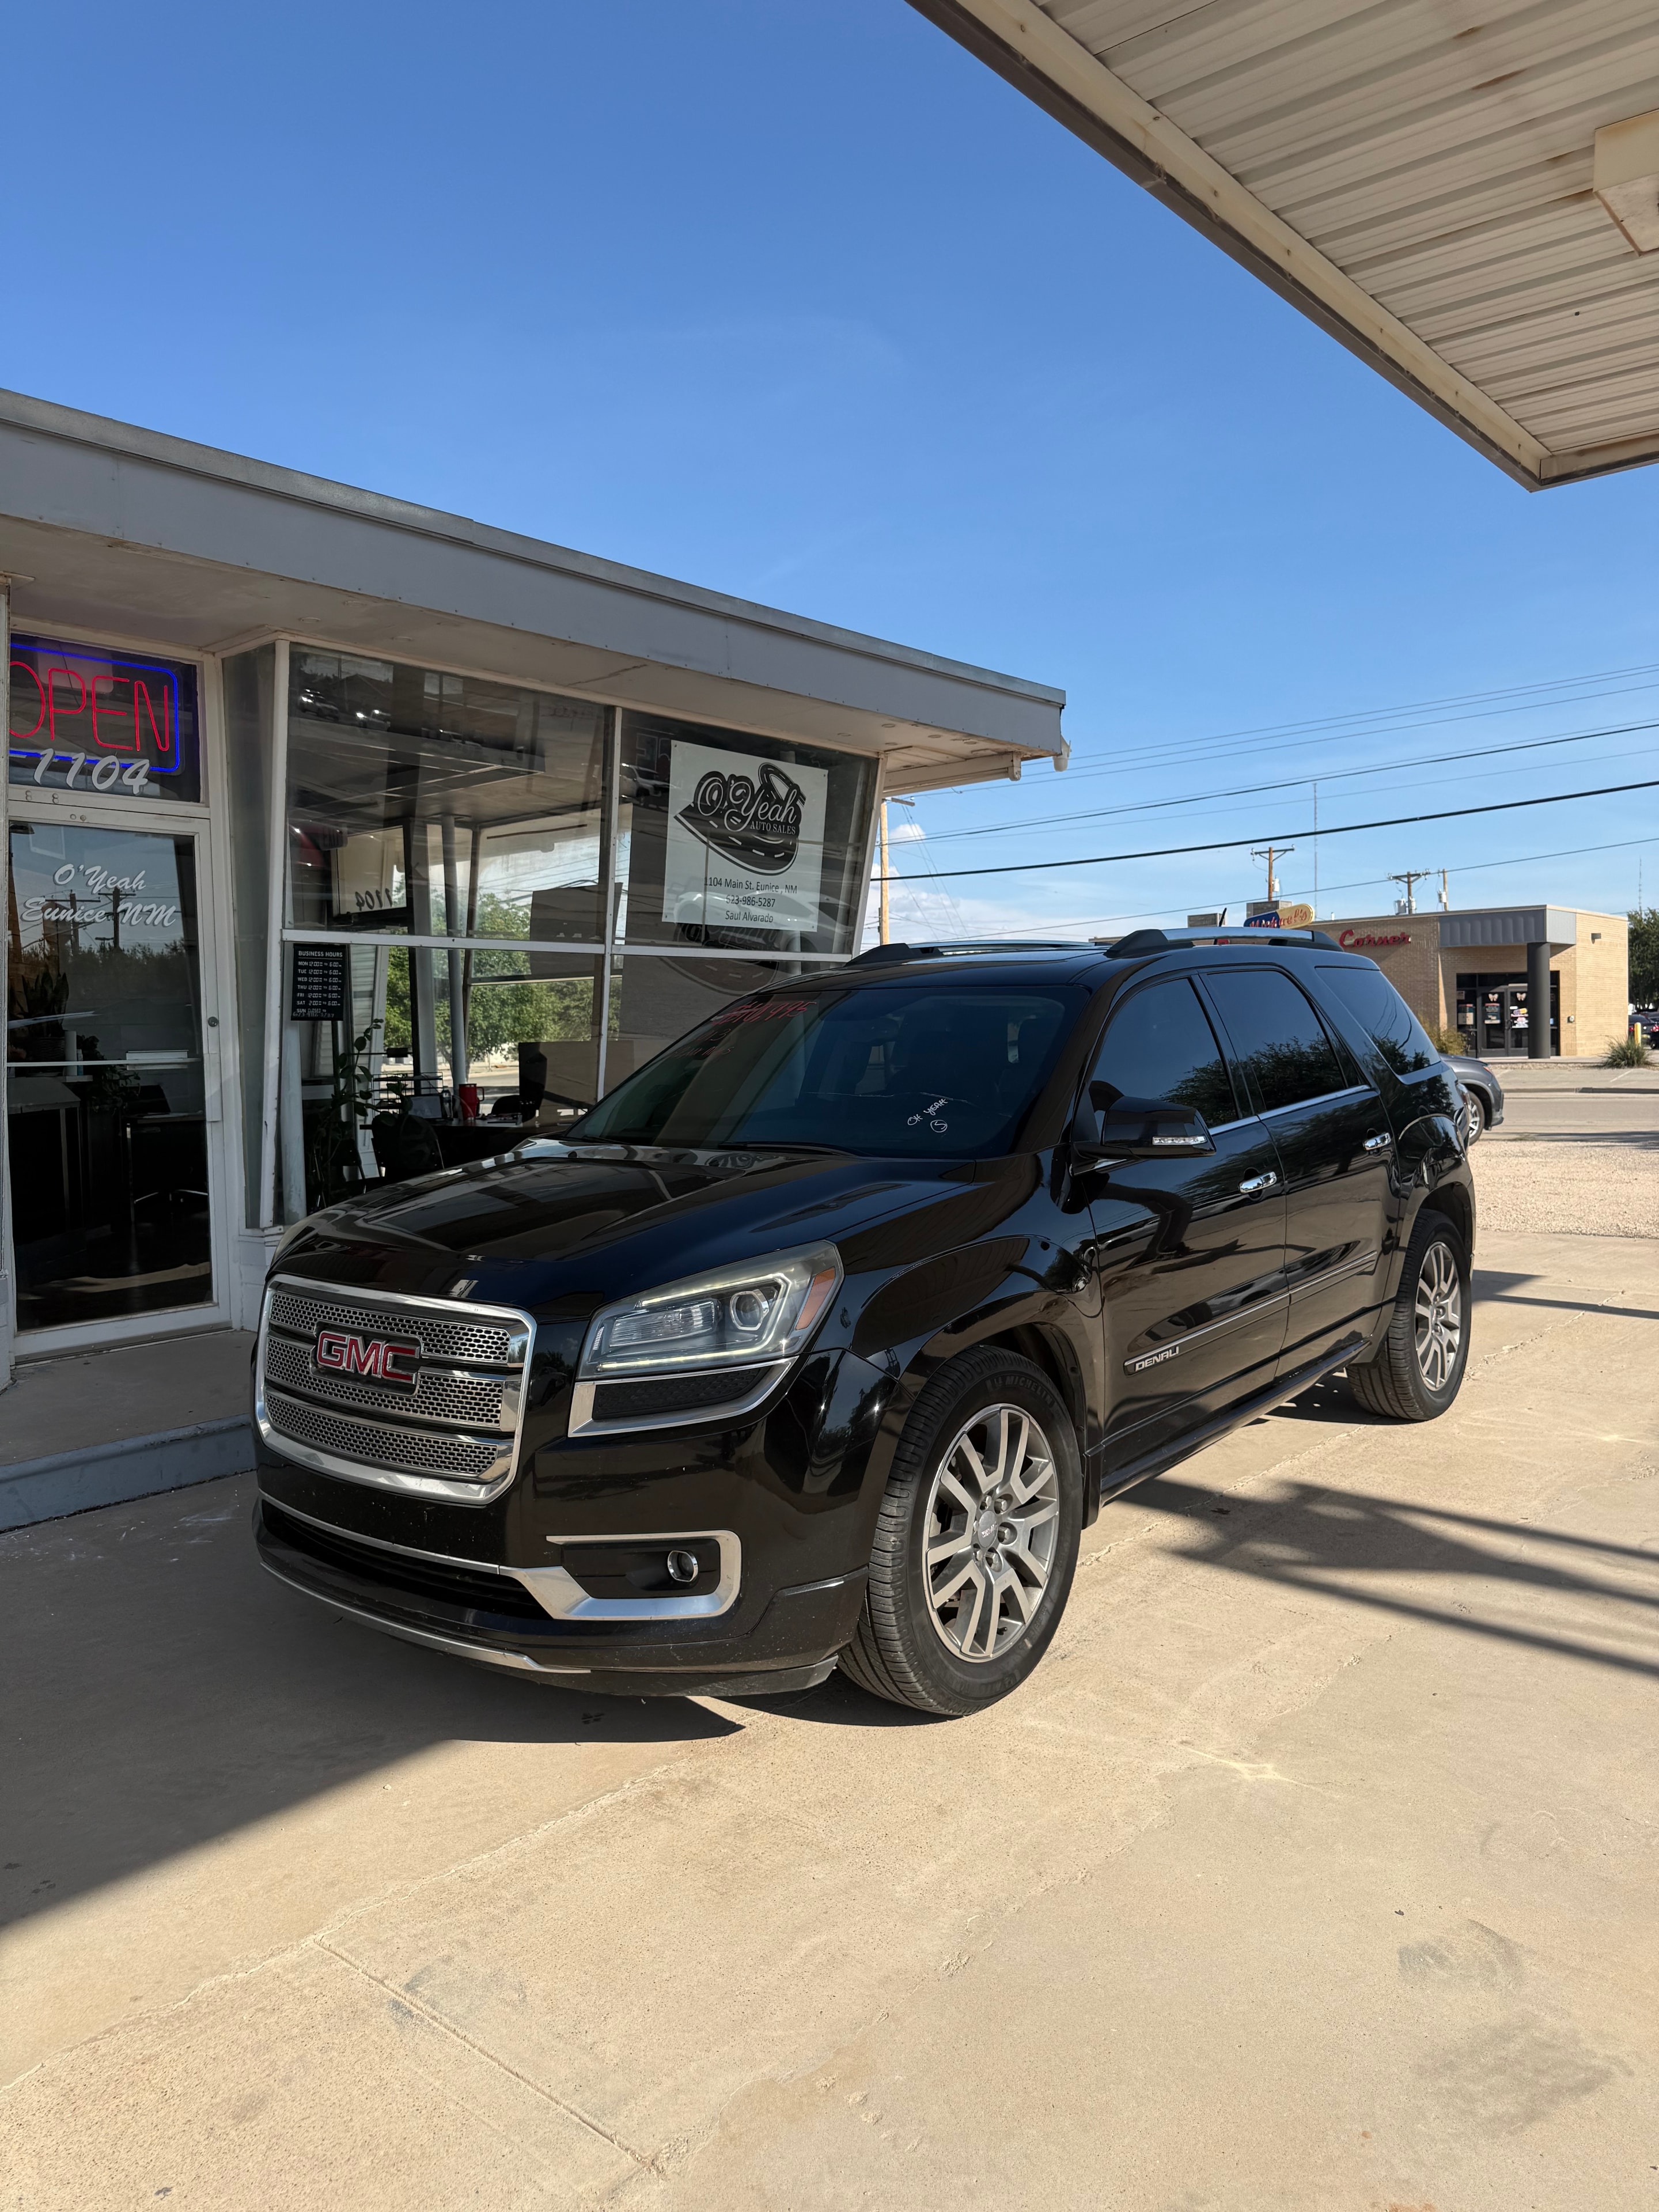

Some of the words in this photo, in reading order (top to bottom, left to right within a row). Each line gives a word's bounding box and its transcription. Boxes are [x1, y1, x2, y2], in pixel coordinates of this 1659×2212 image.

[9, 661, 170, 752] OPEN
[33, 748, 151, 795] 1104
[751, 821, 772, 832] AUTO
[773, 824, 797, 835] SALES
[53, 863, 146, 891] O'Yeah
[704, 877, 723, 887] 1104
[725, 878, 744, 889] Main
[745, 881, 755, 891] St.
[756, 881, 779, 893] Eunice
[785, 884, 798, 894] NM
[21, 897, 107, 923] Eunice
[118, 902, 176, 927] NM
[726, 895, 776, 908] 623-986-5287
[725, 910, 741, 921] Saul
[742, 911, 774, 923] Alvarado
[1339, 929, 1411, 948] Corner
[317, 1331, 420, 1384] GMC
[1135, 1346, 1179, 1371] DENALI
[1005, 1376, 1055, 1408] MICHELIN
